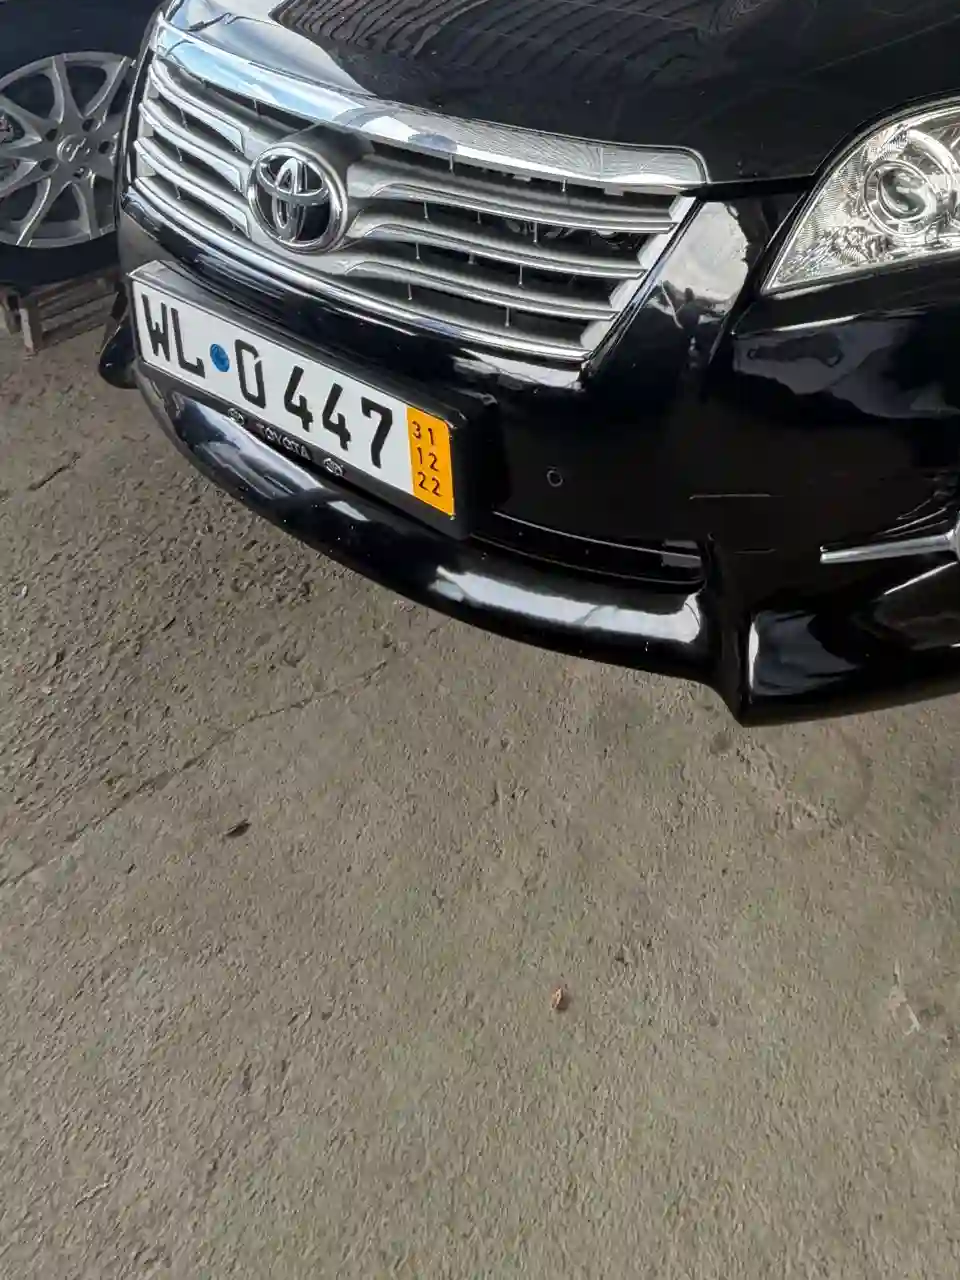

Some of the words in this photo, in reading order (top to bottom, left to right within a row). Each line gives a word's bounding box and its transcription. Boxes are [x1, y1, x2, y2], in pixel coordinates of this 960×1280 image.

[142, 294, 206, 378] WL
[256, 423, 312, 460] TOYOTA
[412, 420, 434, 445] 31
[417, 446, 440, 472] 12
[417, 471, 443, 497] 22
